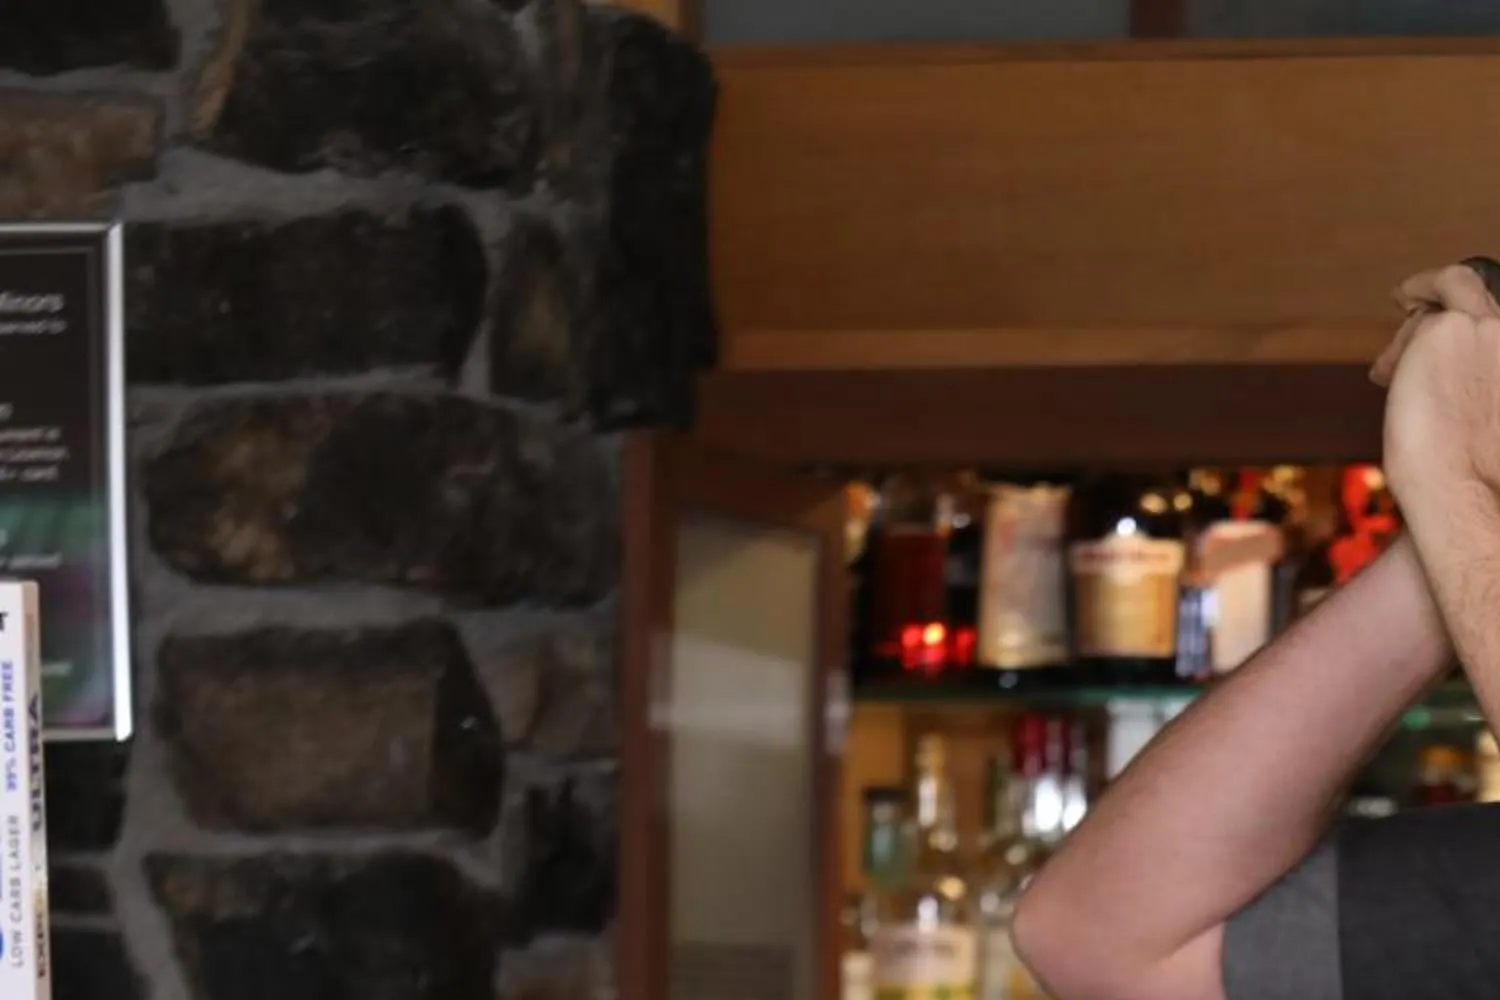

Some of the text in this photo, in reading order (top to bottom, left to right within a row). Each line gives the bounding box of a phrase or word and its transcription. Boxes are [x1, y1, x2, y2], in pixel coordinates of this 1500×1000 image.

[1, 660, 17, 791] 99% CARB FREE
[7, 815, 24, 968] LOW CARB LAGER
